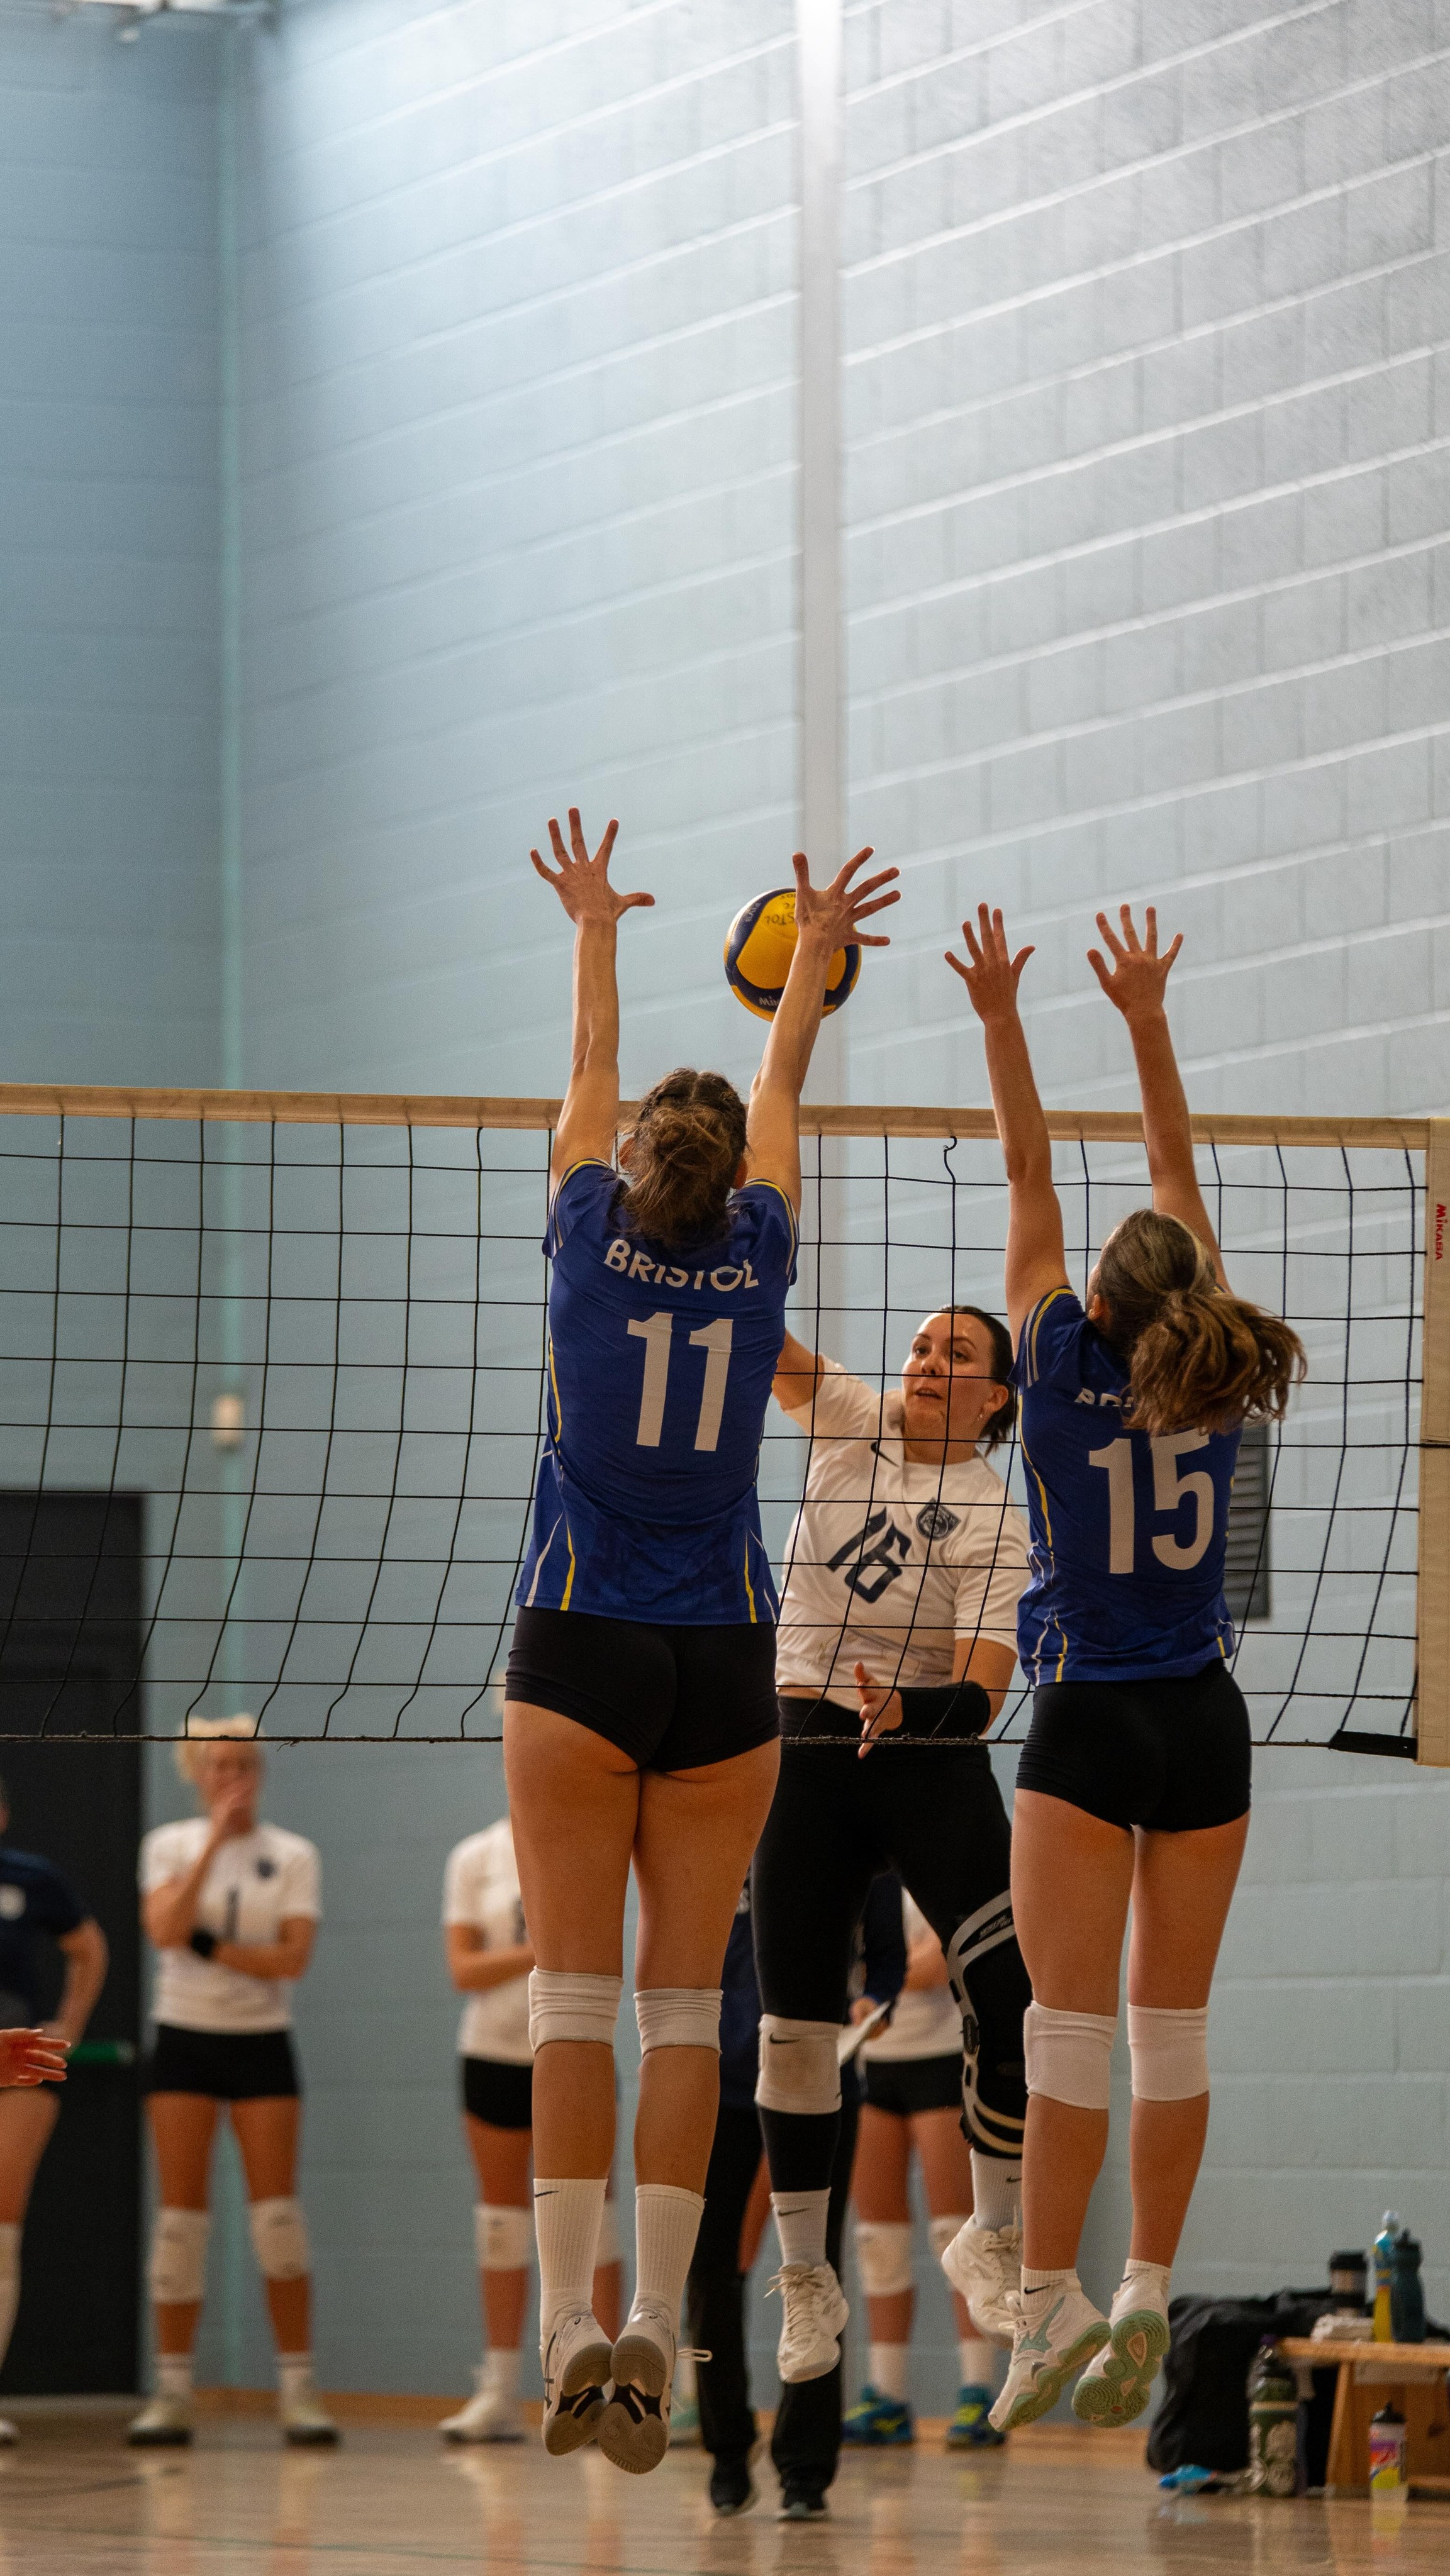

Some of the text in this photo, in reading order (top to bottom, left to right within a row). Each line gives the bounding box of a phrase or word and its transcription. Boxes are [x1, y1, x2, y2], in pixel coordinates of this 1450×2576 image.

[764, 913, 795, 926] STOL
[604, 1239, 759, 1291] BRISTOL
[627, 1312, 733, 1451] 11
[1089, 1427, 1214, 1574] 15
[827, 1506, 912, 1603] 16
